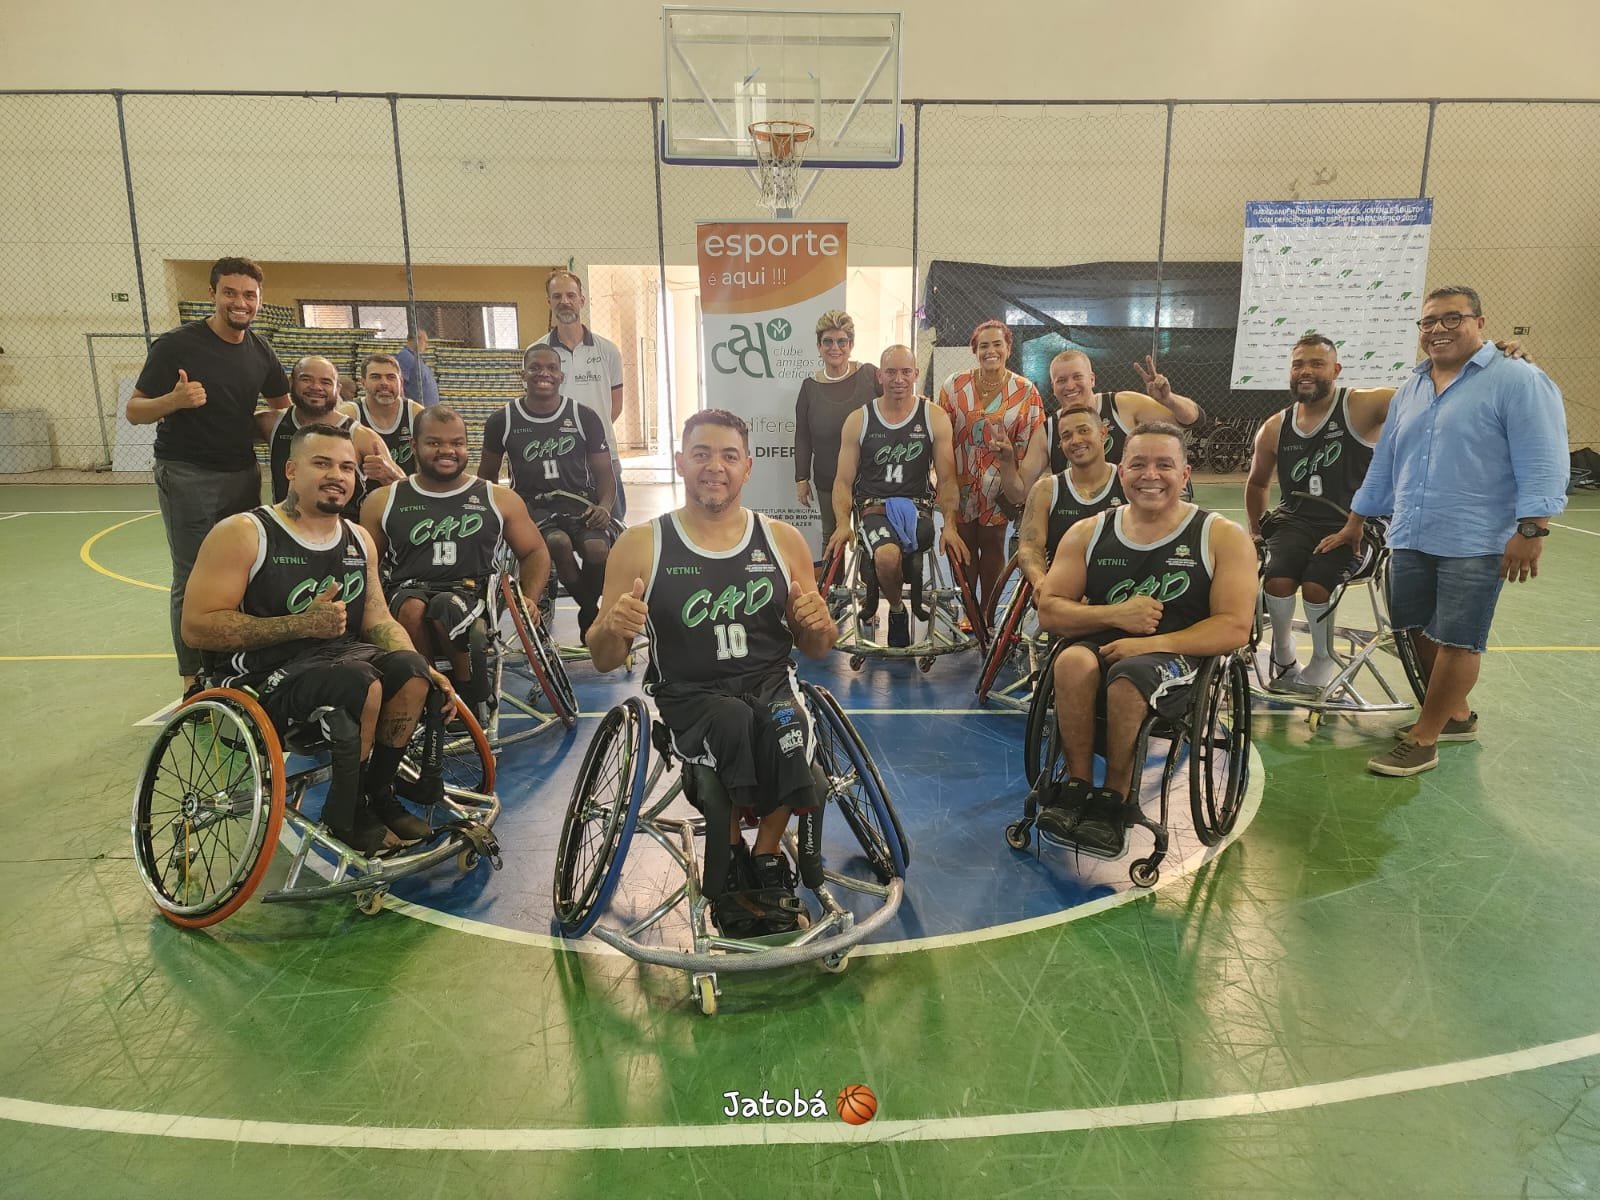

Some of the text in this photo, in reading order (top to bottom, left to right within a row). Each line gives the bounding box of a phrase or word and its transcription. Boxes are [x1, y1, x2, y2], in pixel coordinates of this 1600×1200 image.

[704, 229, 839, 263] esporte
[721, 266, 765, 288] aqui
[778, 367, 816, 379] deficie
[747, 416, 797, 433] difere
[522, 434, 577, 463] CAD
[755, 446, 796, 458] DIFE
[873, 440, 924, 466] CAD
[542, 459, 560, 480] 11
[1290, 439, 1343, 483] CAD
[884, 463, 904, 484] 14
[409, 512, 484, 546] CAD
[272, 556, 307, 565] VETNIL
[666, 566, 701, 575] VETNIL
[1097, 558, 1127, 567] VETNIL
[681, 576, 774, 628] CAD
[713, 623, 749, 661] 10
